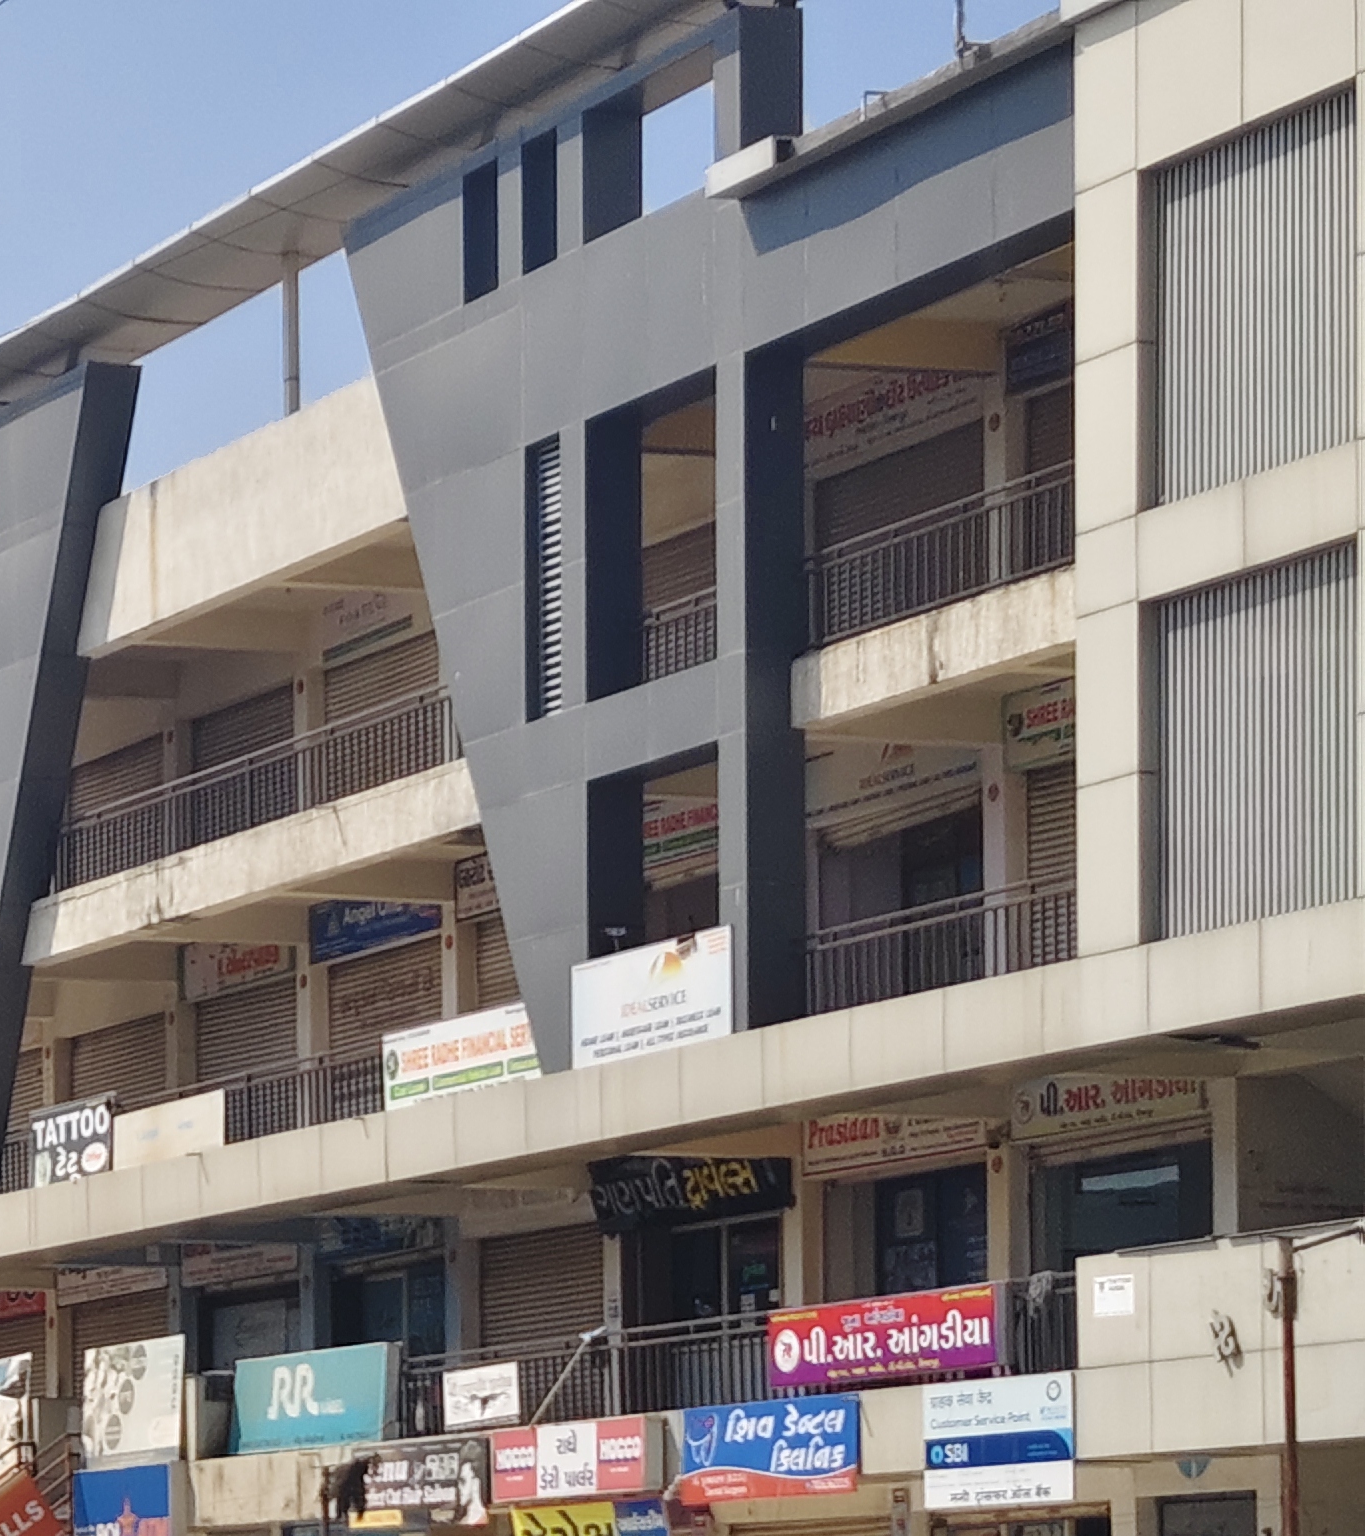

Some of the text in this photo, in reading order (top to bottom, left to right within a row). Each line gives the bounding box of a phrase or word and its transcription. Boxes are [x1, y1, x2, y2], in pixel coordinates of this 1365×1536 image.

[32, 1104, 110, 1151] TATTOO
[886, 1309, 990, 1355] આંગડીયા
[724, 1408, 775, 1443] શિવ
[972, 1414, 1006, 1426] Service
[944, 1443, 969, 1464] SBI
